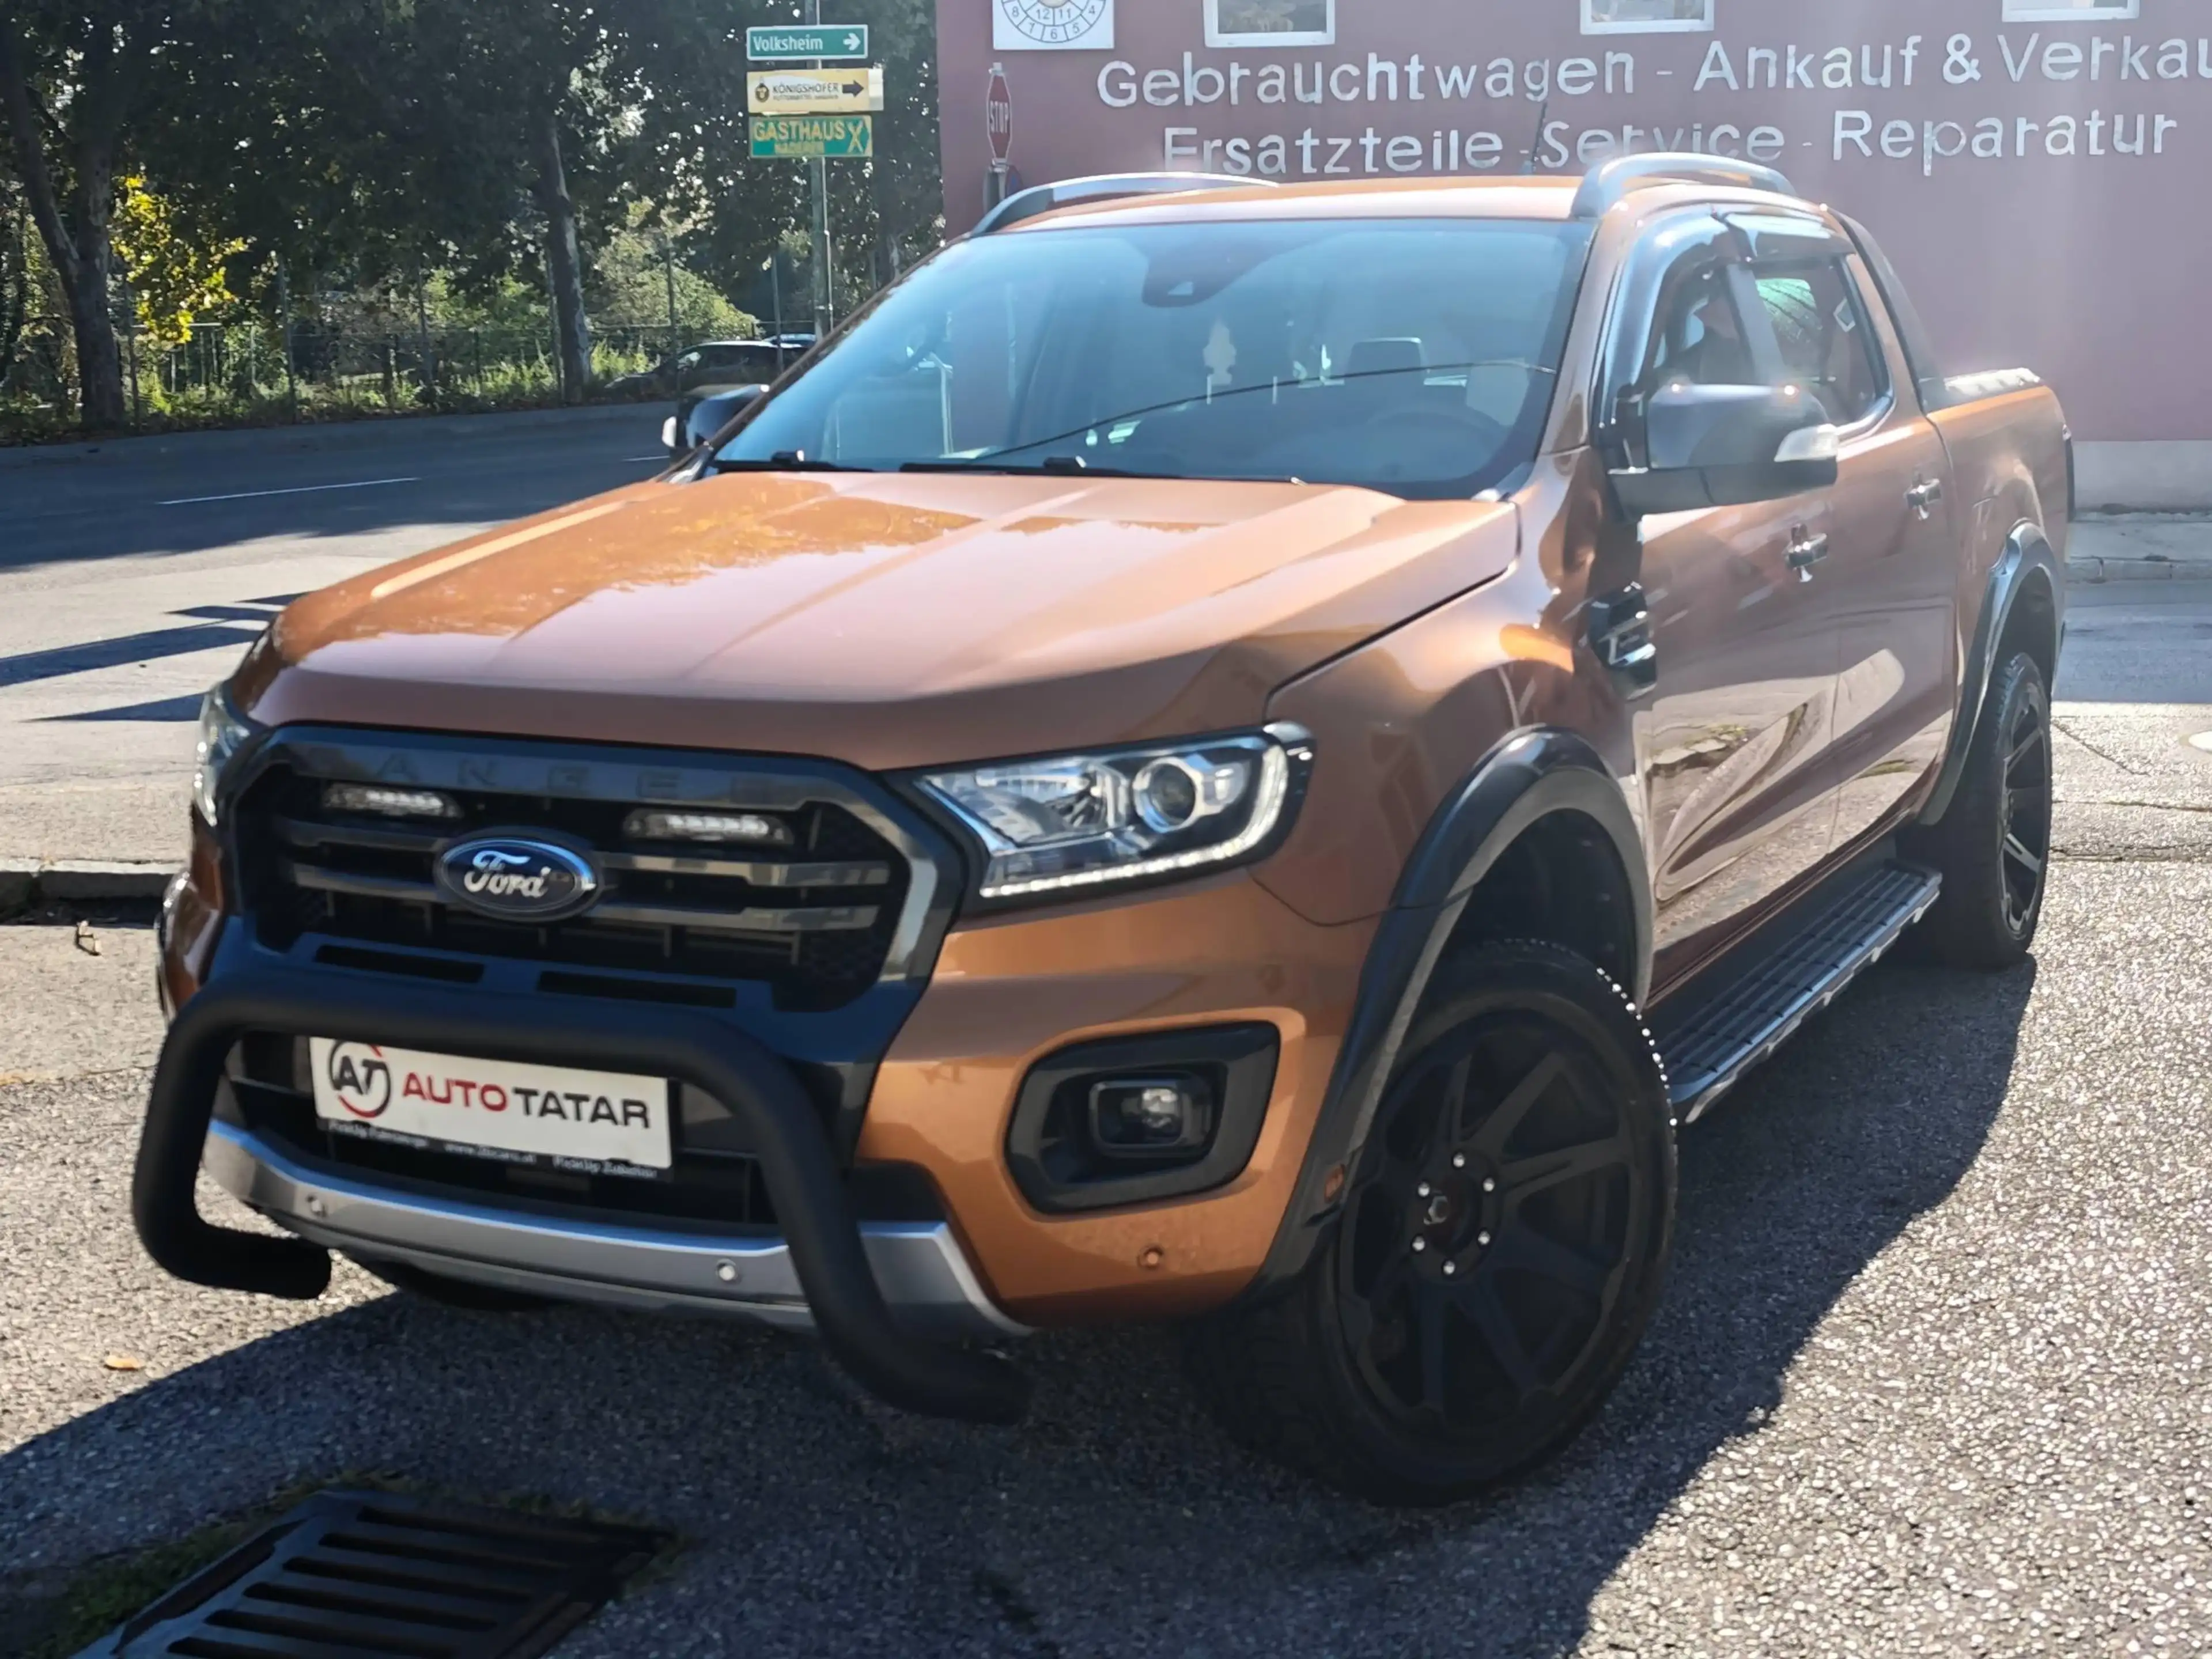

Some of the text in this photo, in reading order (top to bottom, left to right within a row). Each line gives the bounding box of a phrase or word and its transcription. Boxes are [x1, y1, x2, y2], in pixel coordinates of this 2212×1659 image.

[1011, 5, 1095, 39] 8 7 6 5 4
[1036, 9, 1071, 20] 12 11
[753, 35, 823, 51] Volksheim
[1097, 51, 1634, 108] Gebrauchtwagen
[1693, 35, 1922, 92] Ankauf
[1942, 33, 1982, 85] &
[773, 82, 839, 94] KÖNIGSHOFER
[753, 120, 845, 141] GASTHAUS
[1164, 126, 1504, 176] Ersatzteile
[1540, 119, 1786, 169] Service
[1833, 108, 2177, 176] Reparatur
[463, 850, 551, 898] Ford
[333, 1054, 651, 1129] AT AUTO TATAR
